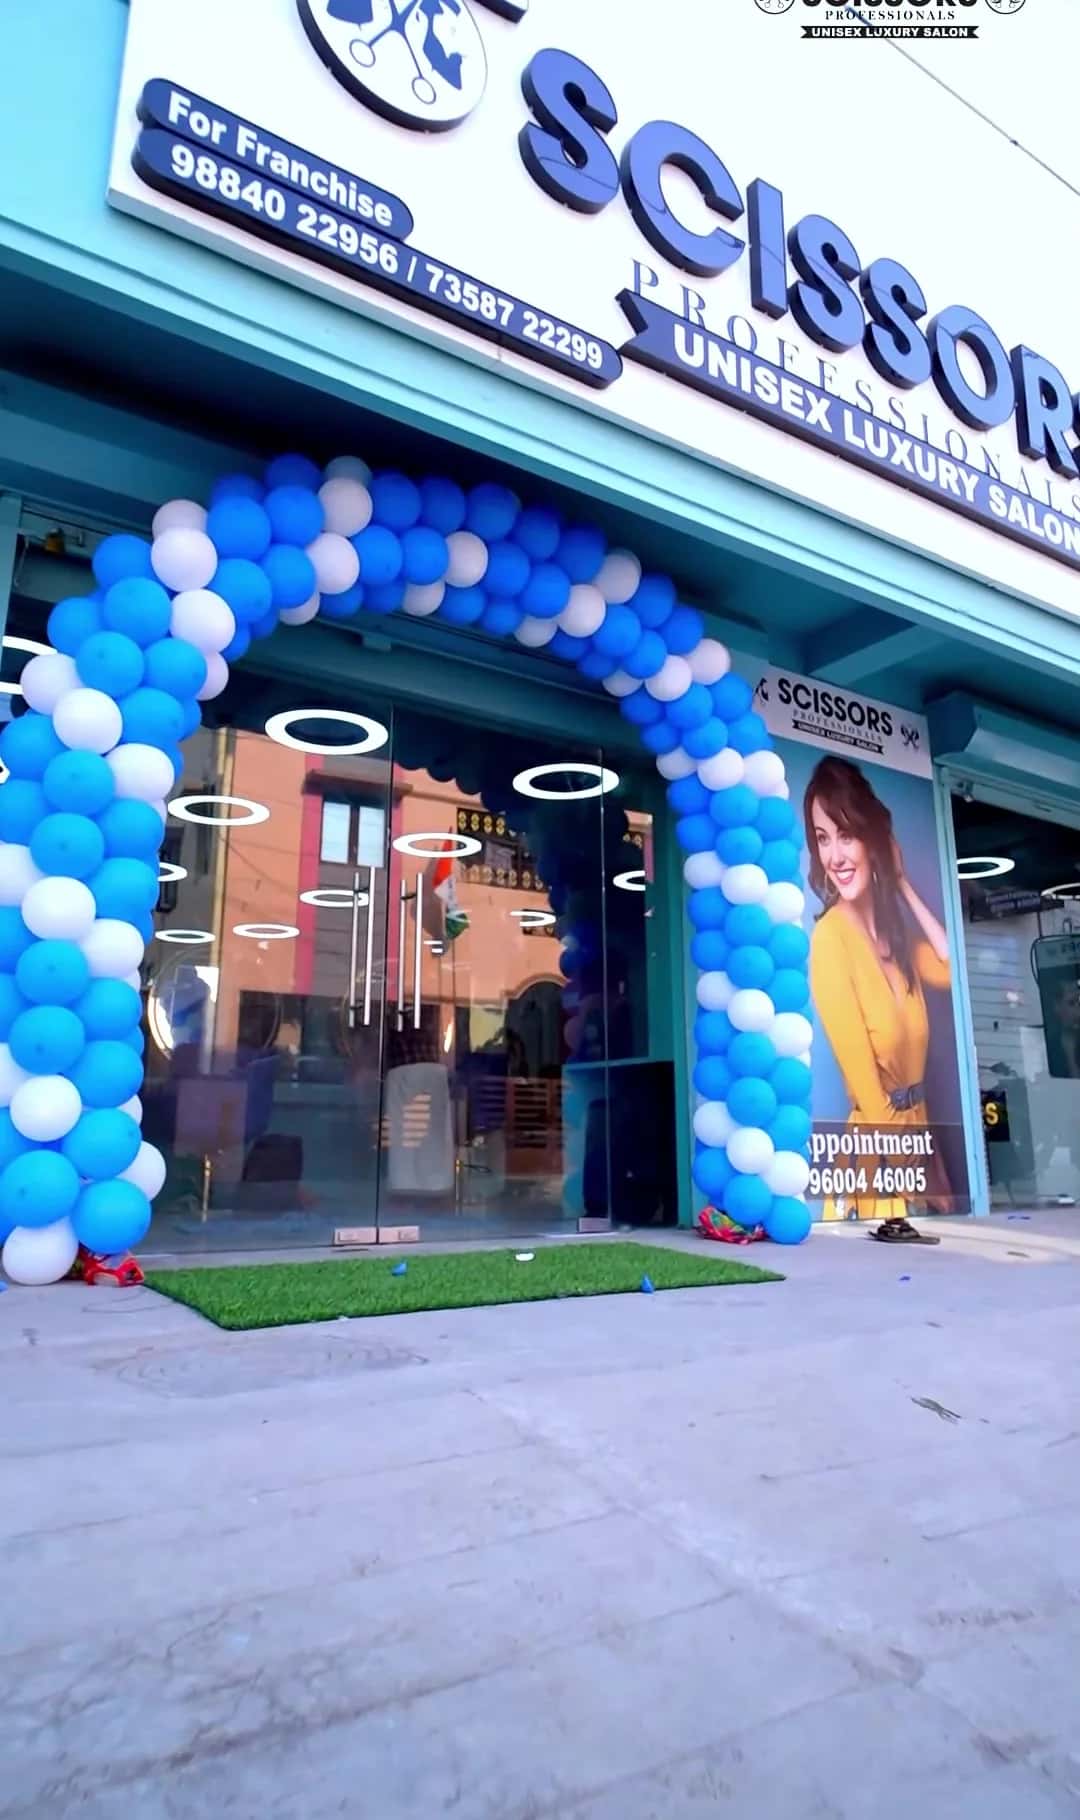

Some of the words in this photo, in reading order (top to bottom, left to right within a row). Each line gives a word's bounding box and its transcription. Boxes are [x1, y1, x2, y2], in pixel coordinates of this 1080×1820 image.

[168, 91, 227, 144] For
[236, 124, 393, 227] Franchise
[171, 144, 286, 221] 98840
[296, 204, 398, 274] 22956
[426, 263, 514, 327] 73587
[523, 310, 603, 370] 22299
[518, 47, 1080, 479] SCISSOR
[674, 322, 832, 434] UNISEX
[843, 418, 979, 504] LUXURY
[988, 483, 1080, 555] SALON
[778, 678, 893, 737] SCISSORS
[806, 1127, 934, 1162] ppointment
[810, 1167, 867, 1195] 96004
[872, 1167, 926, 1192] 46005
